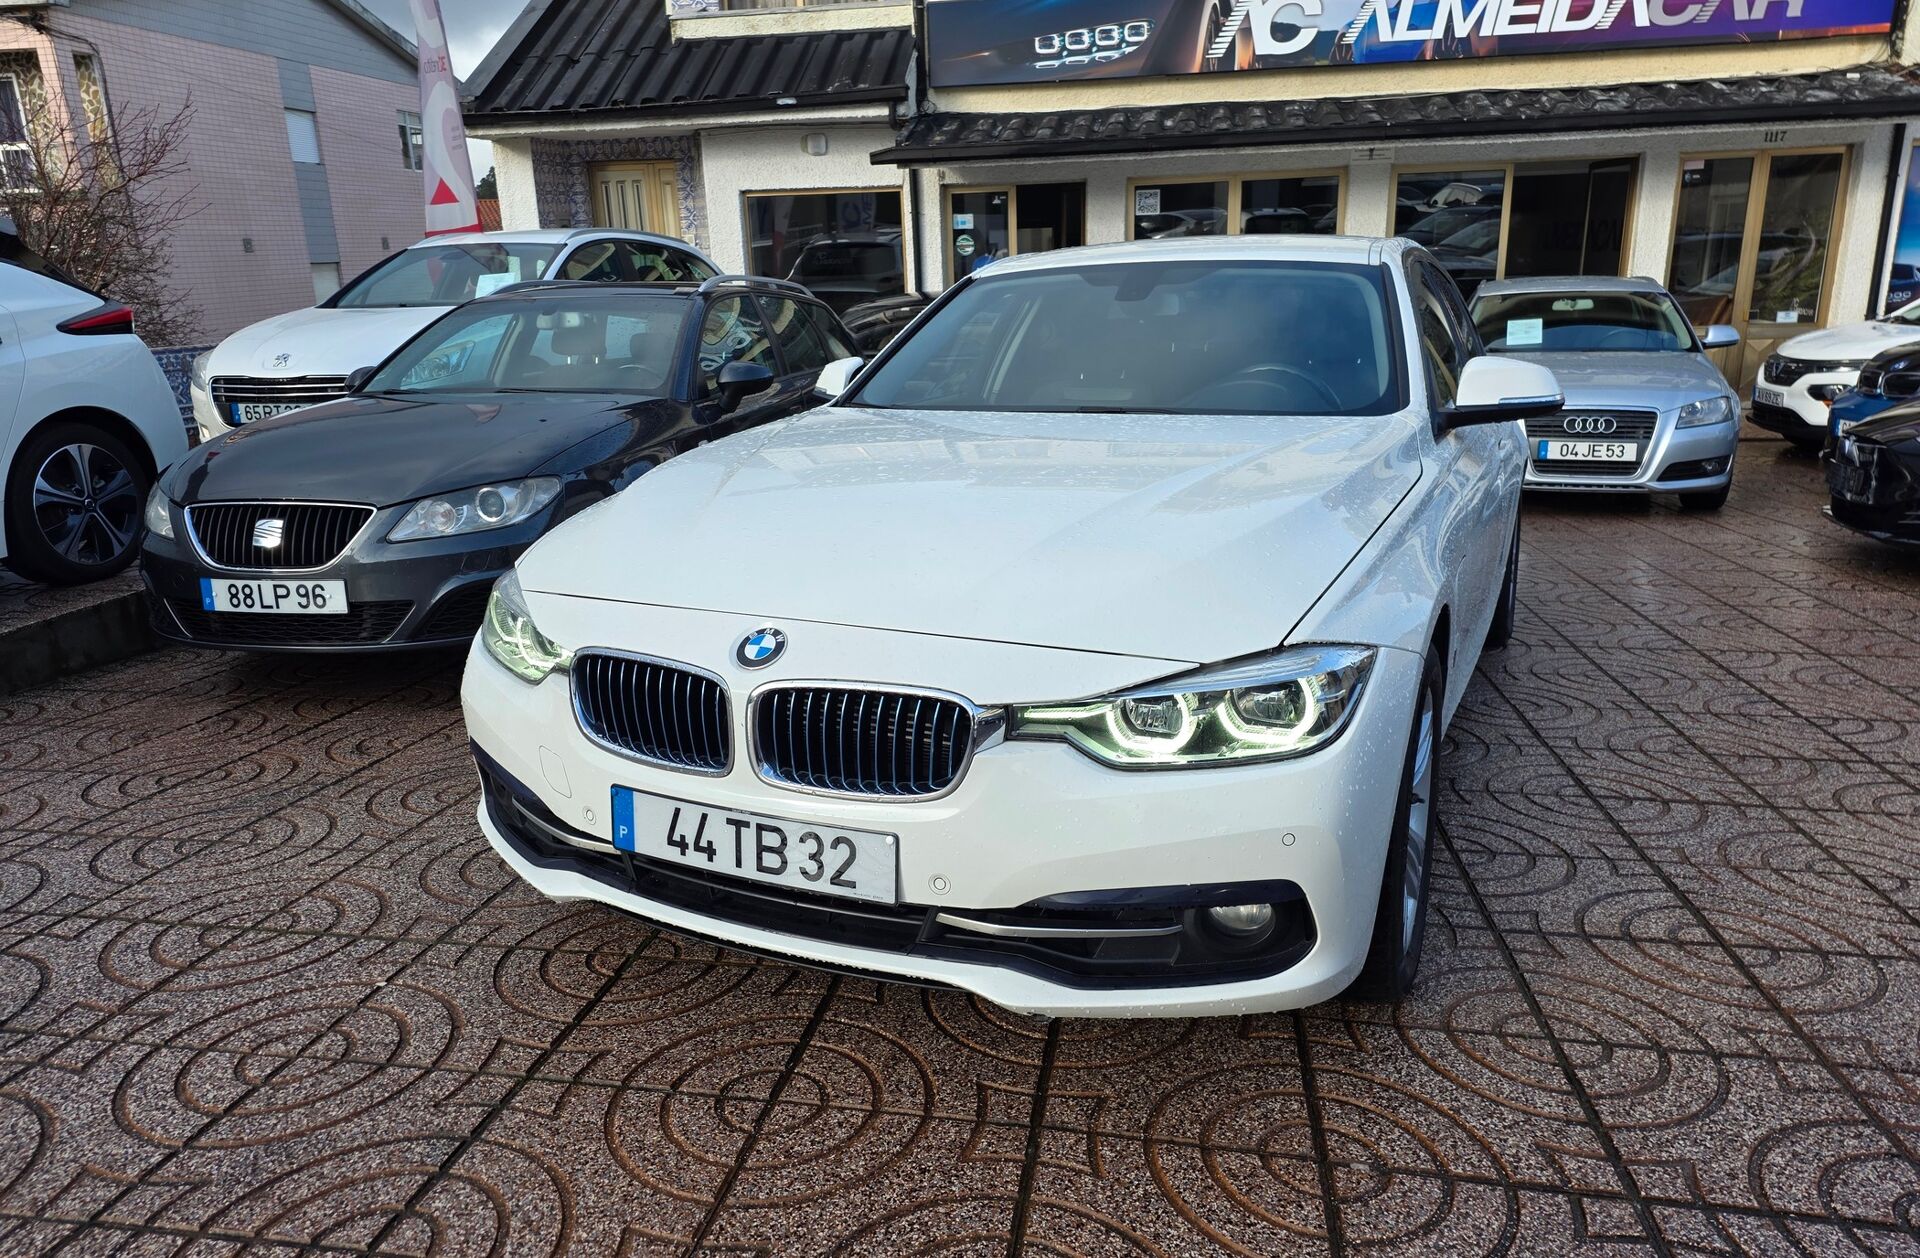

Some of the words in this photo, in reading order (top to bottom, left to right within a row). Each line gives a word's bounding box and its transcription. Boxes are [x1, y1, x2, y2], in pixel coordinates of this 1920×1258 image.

[1764, 131, 1787, 143] 1117
[244, 405, 303, 421] 65RT
[748, 628, 785, 642] BMW
[619, 825, 628, 838] P
